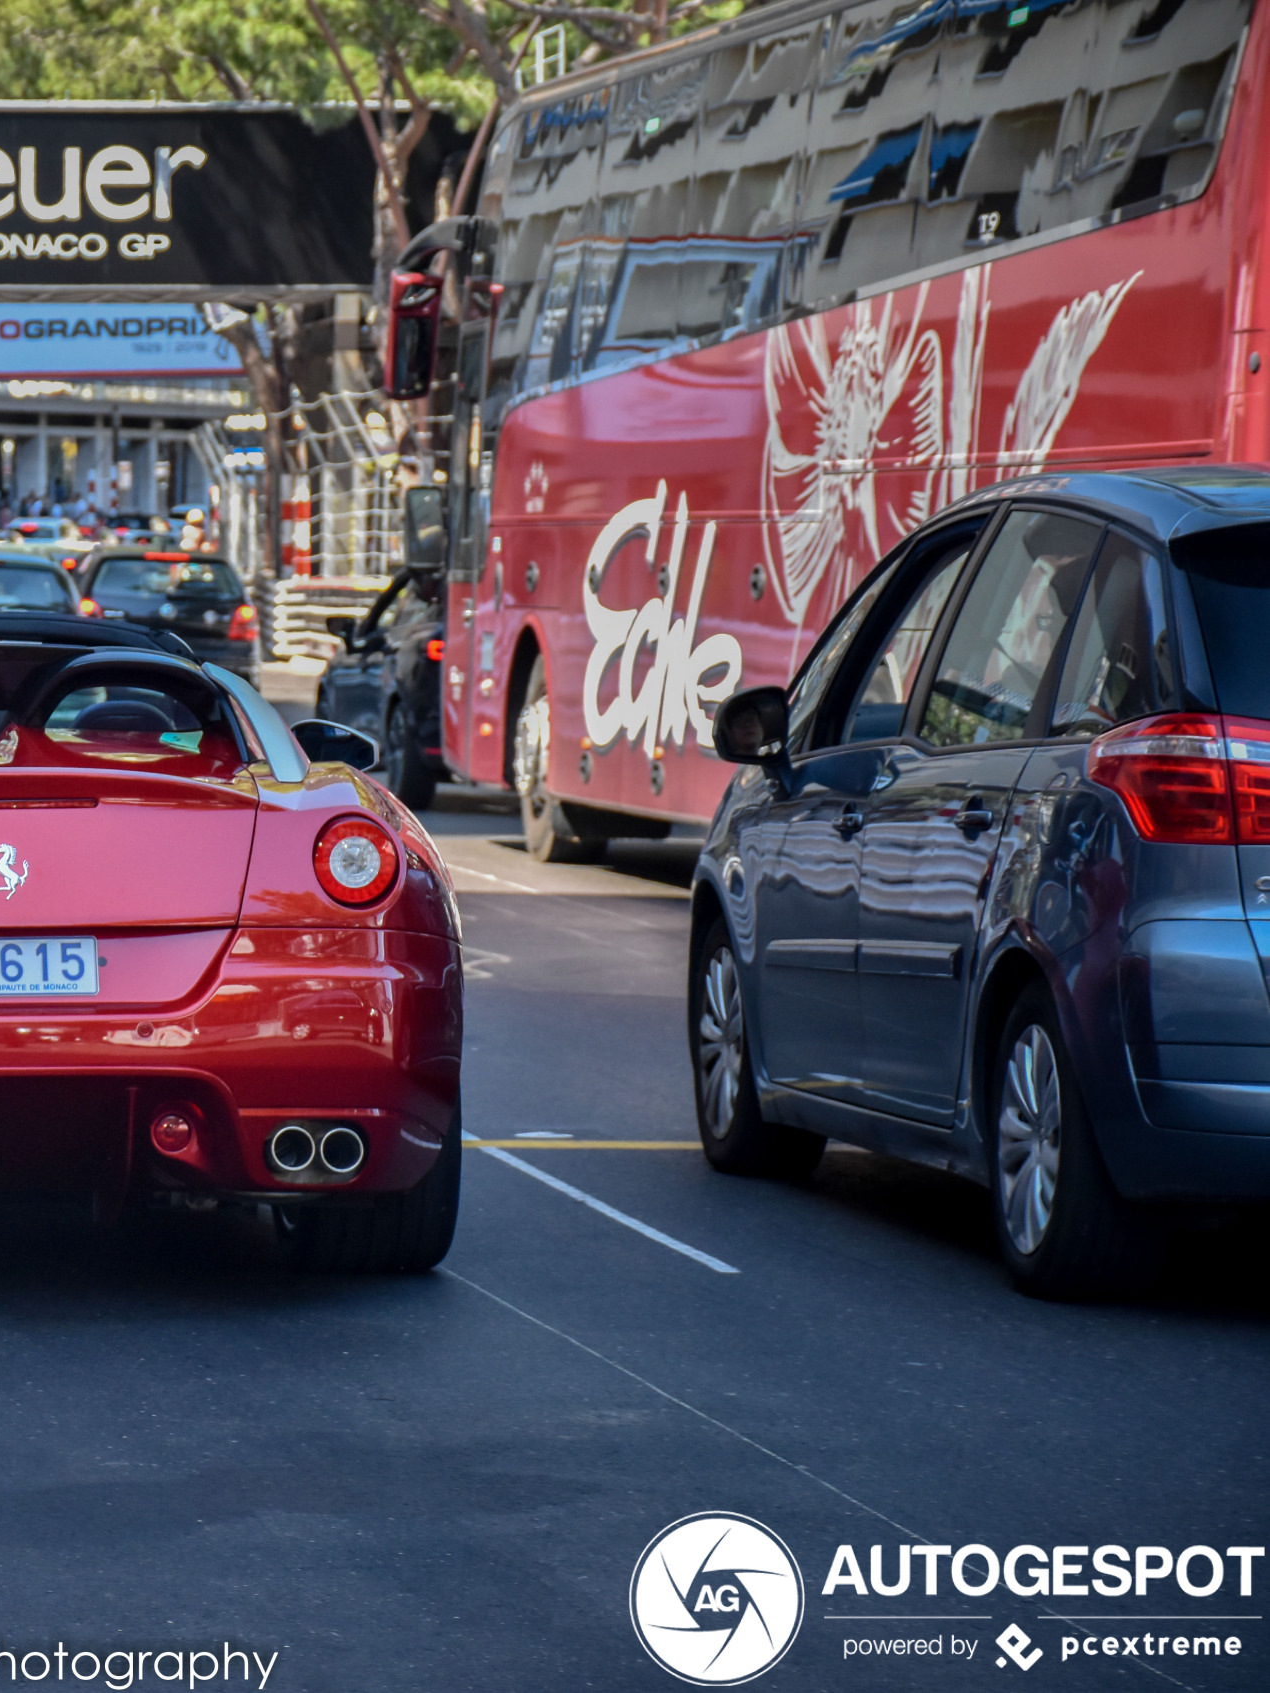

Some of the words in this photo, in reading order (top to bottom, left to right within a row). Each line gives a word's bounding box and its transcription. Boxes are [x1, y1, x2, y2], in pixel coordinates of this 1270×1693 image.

[119, 233, 170, 259] GP
[30, 983, 40, 991] DE
[43, 983, 78, 991] MONACO
